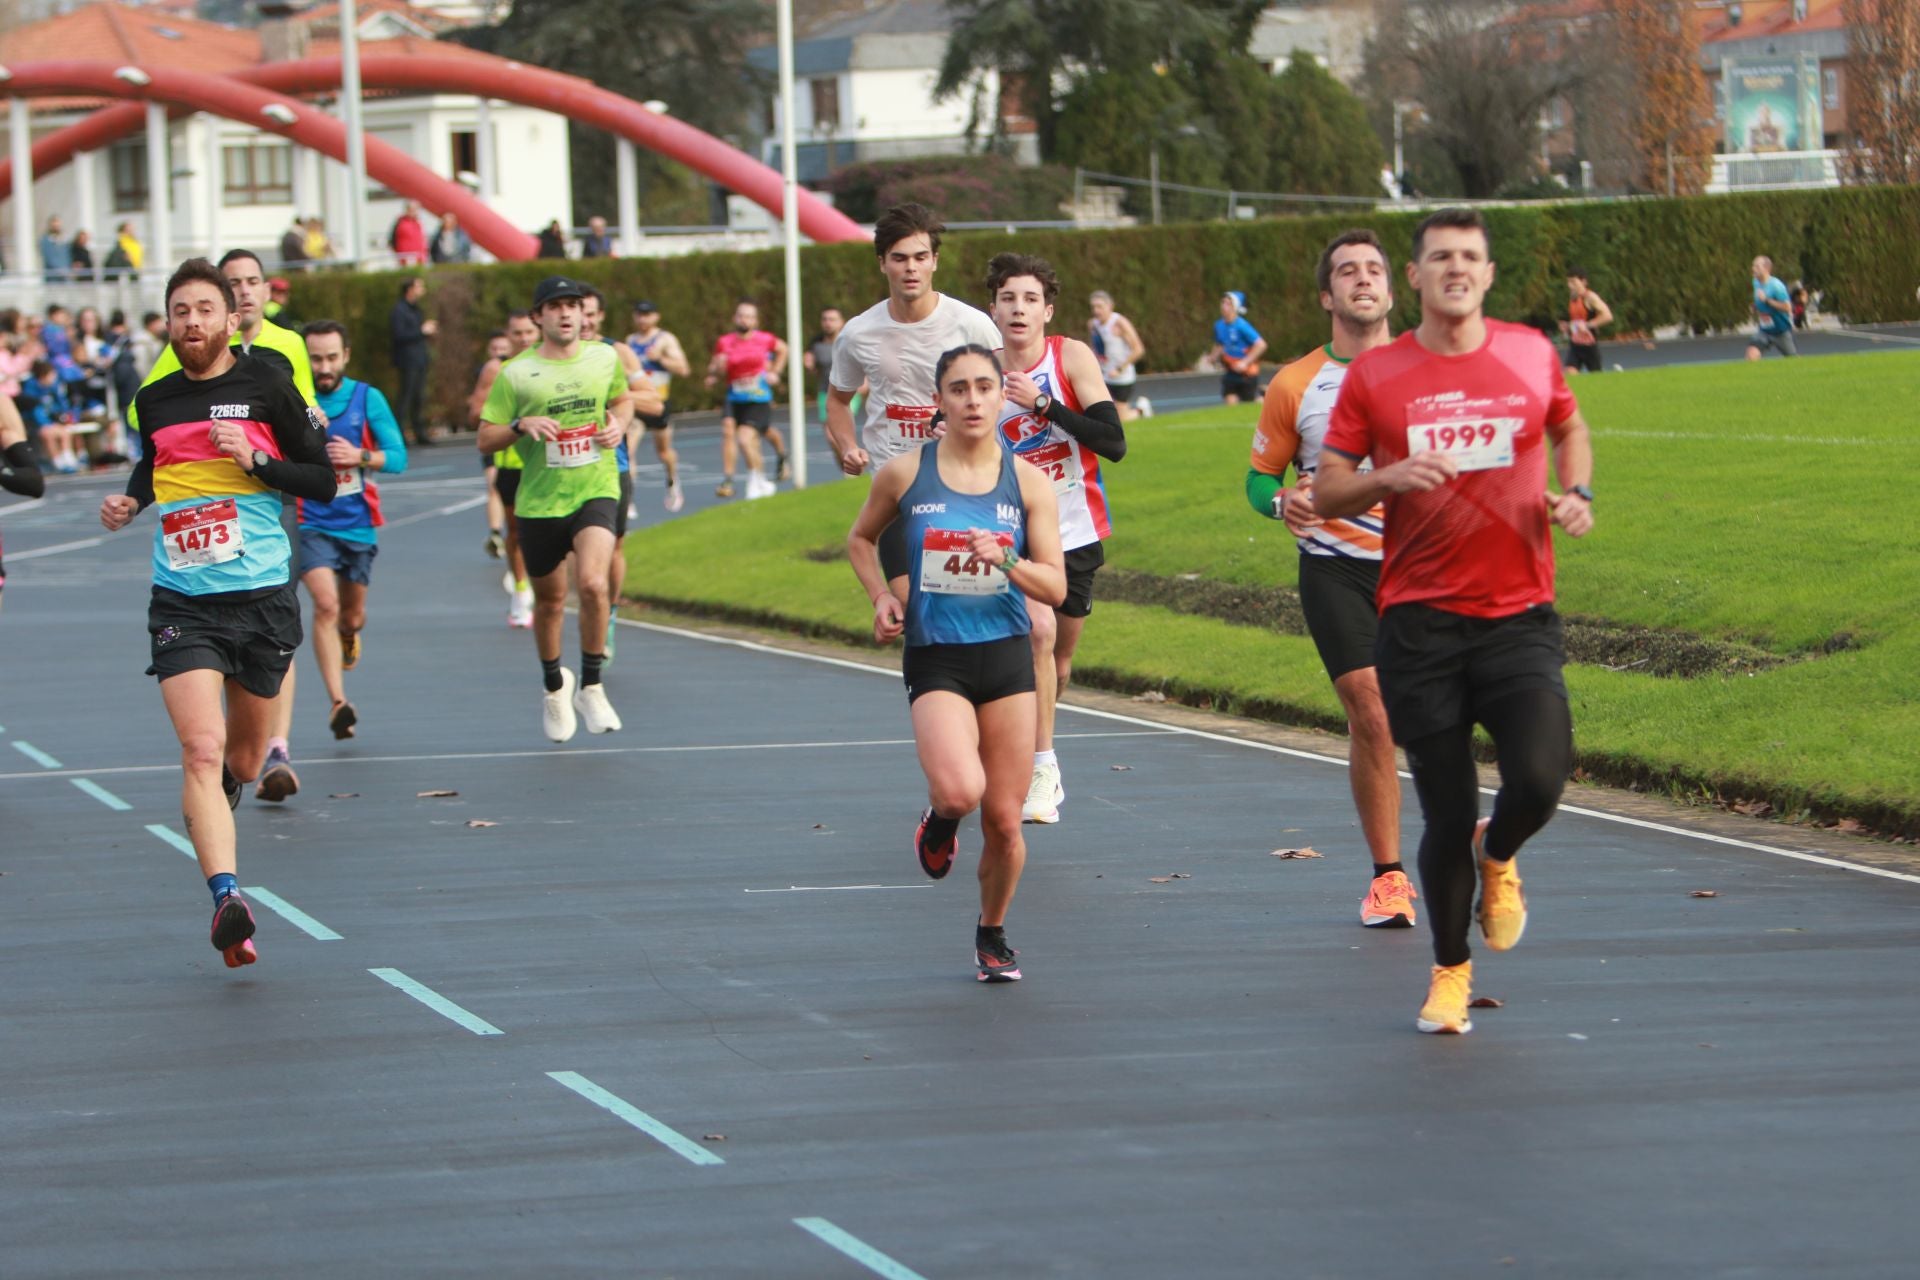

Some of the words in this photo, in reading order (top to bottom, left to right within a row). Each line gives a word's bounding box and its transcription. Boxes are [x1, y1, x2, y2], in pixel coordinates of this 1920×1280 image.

[209, 405, 250, 418] 226ERS
[899, 422, 932, 438] 111
[1424, 423, 1496, 450] 1999
[558, 441, 590, 456] 1114
[912, 504, 947, 516] NOONE
[175, 523, 230, 554] 1473
